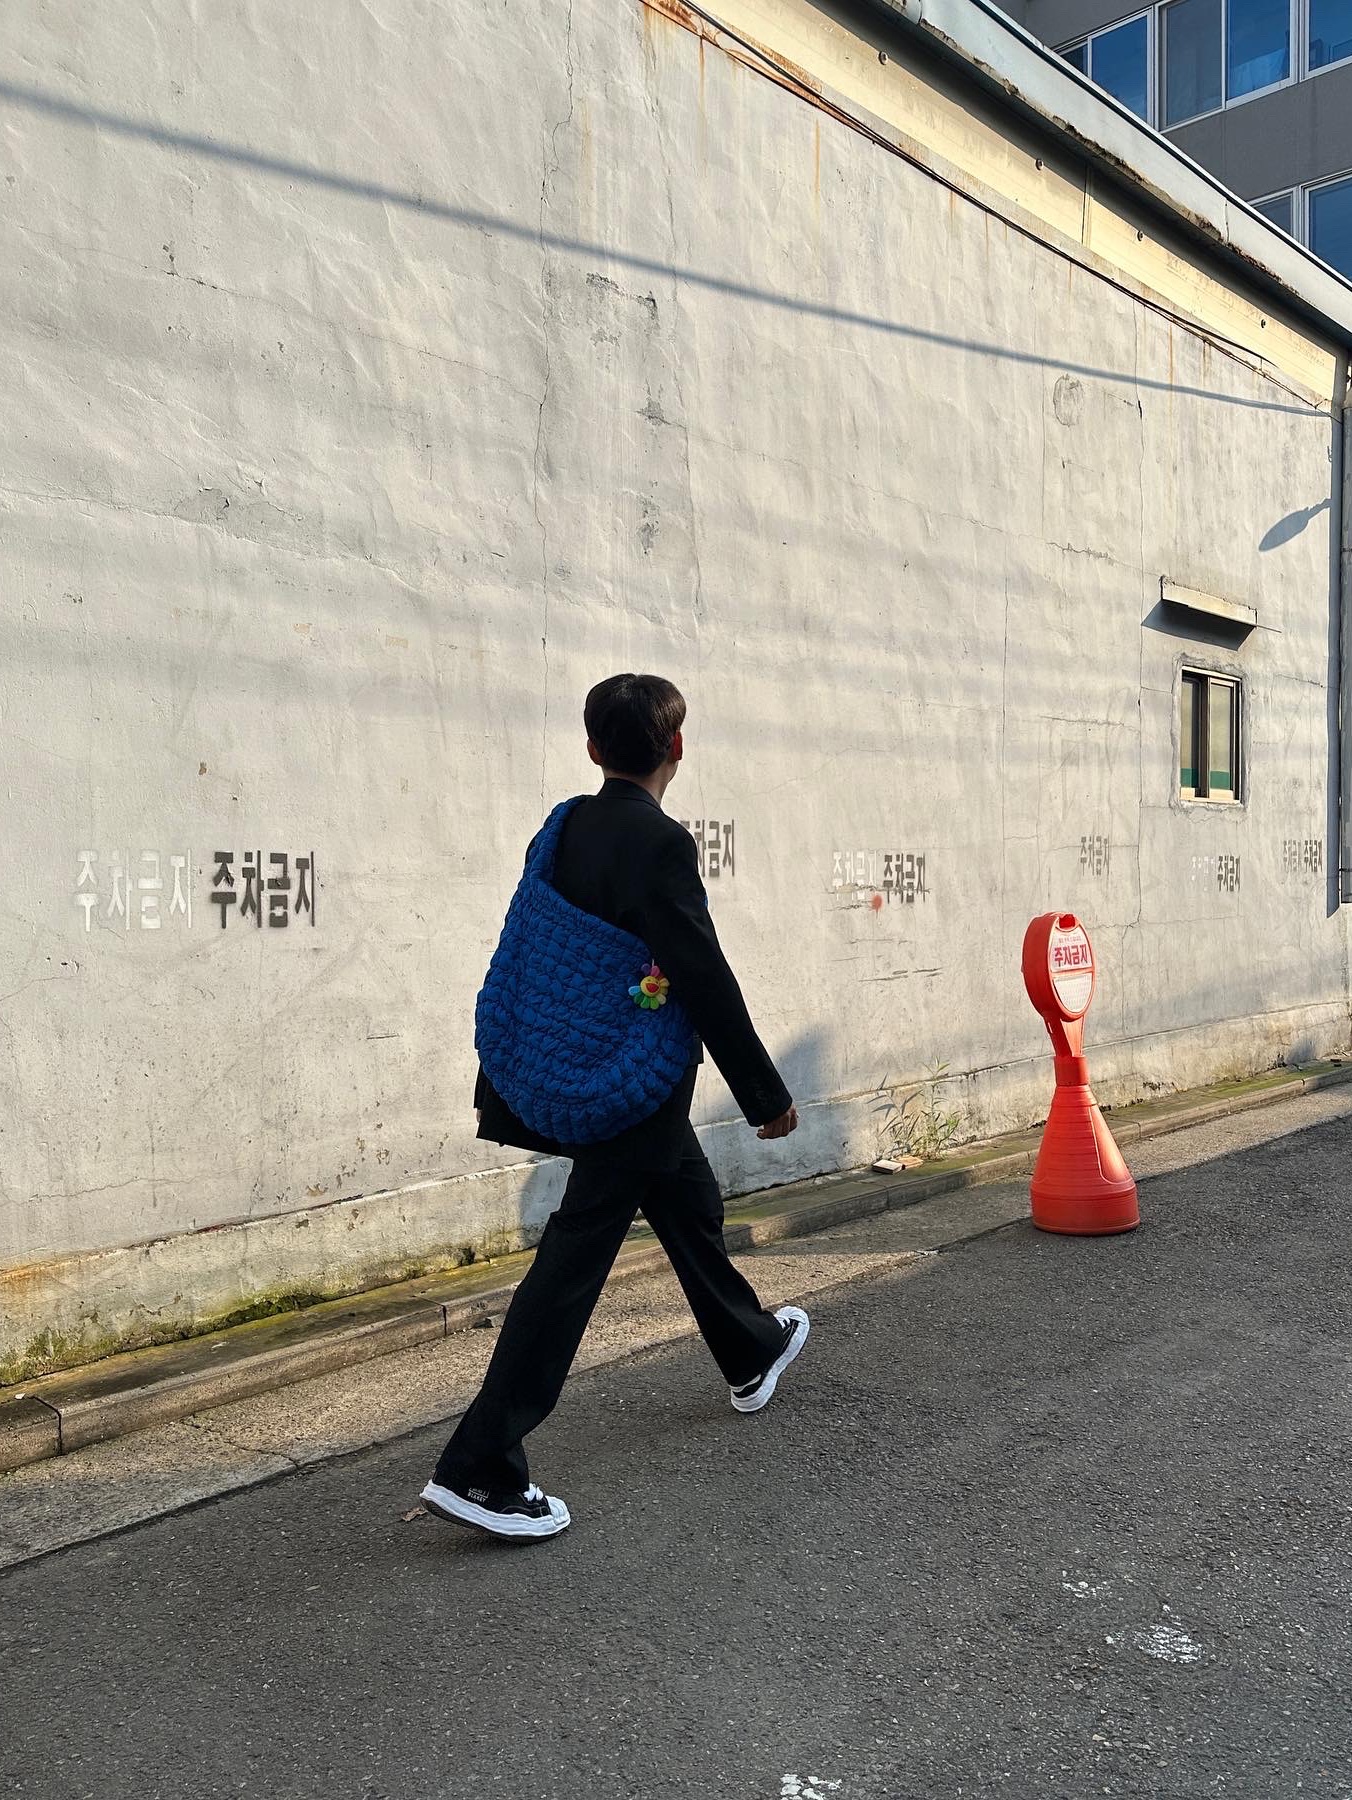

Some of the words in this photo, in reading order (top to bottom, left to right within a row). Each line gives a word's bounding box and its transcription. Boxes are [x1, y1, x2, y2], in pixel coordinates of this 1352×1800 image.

[680, 819, 735, 877] 차금지
[1080, 835, 1110, 876] 주차금지
[1217, 855, 1241, 892] 주차금지
[1304, 839, 1323, 873] 주차금지
[75, 849, 192, 932] 주차금지
[211, 850, 315, 929] 주차금지
[832, 850, 877, 901] 주차금지
[883, 852, 925, 904] 주차금지
